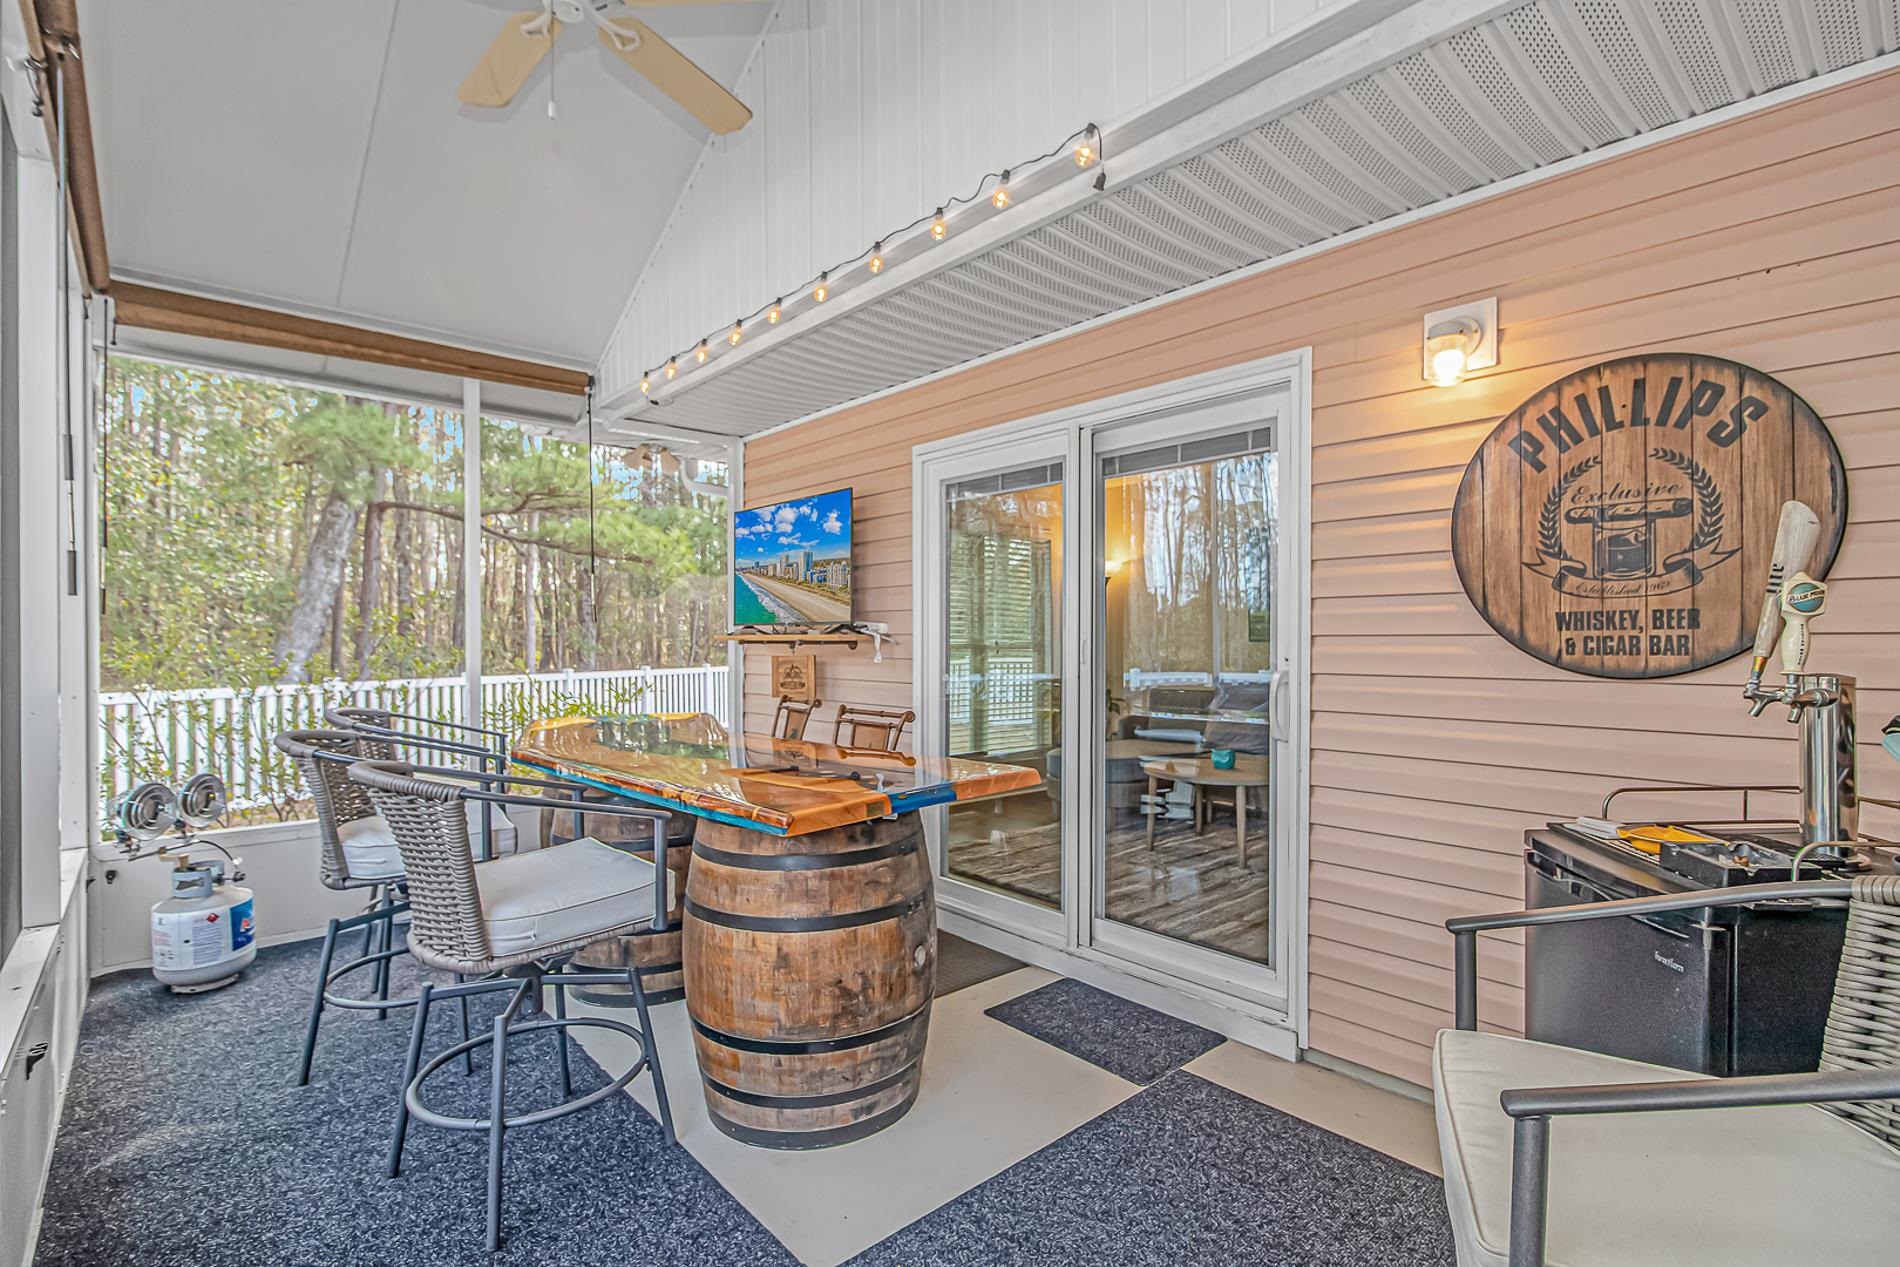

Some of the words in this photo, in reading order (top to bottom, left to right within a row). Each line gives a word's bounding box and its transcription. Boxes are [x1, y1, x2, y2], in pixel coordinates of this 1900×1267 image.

[1507, 376, 1769, 474] PHILLIPS
[1571, 482, 1684, 504] Exclusive
[1555, 609, 1644, 634] WHISKEY,
[1652, 608, 1700, 630] BEER
[1565, 637, 1577, 656] &
[1583, 635, 1641, 656] CIGAR
[1649, 634, 1690, 656] BAR
